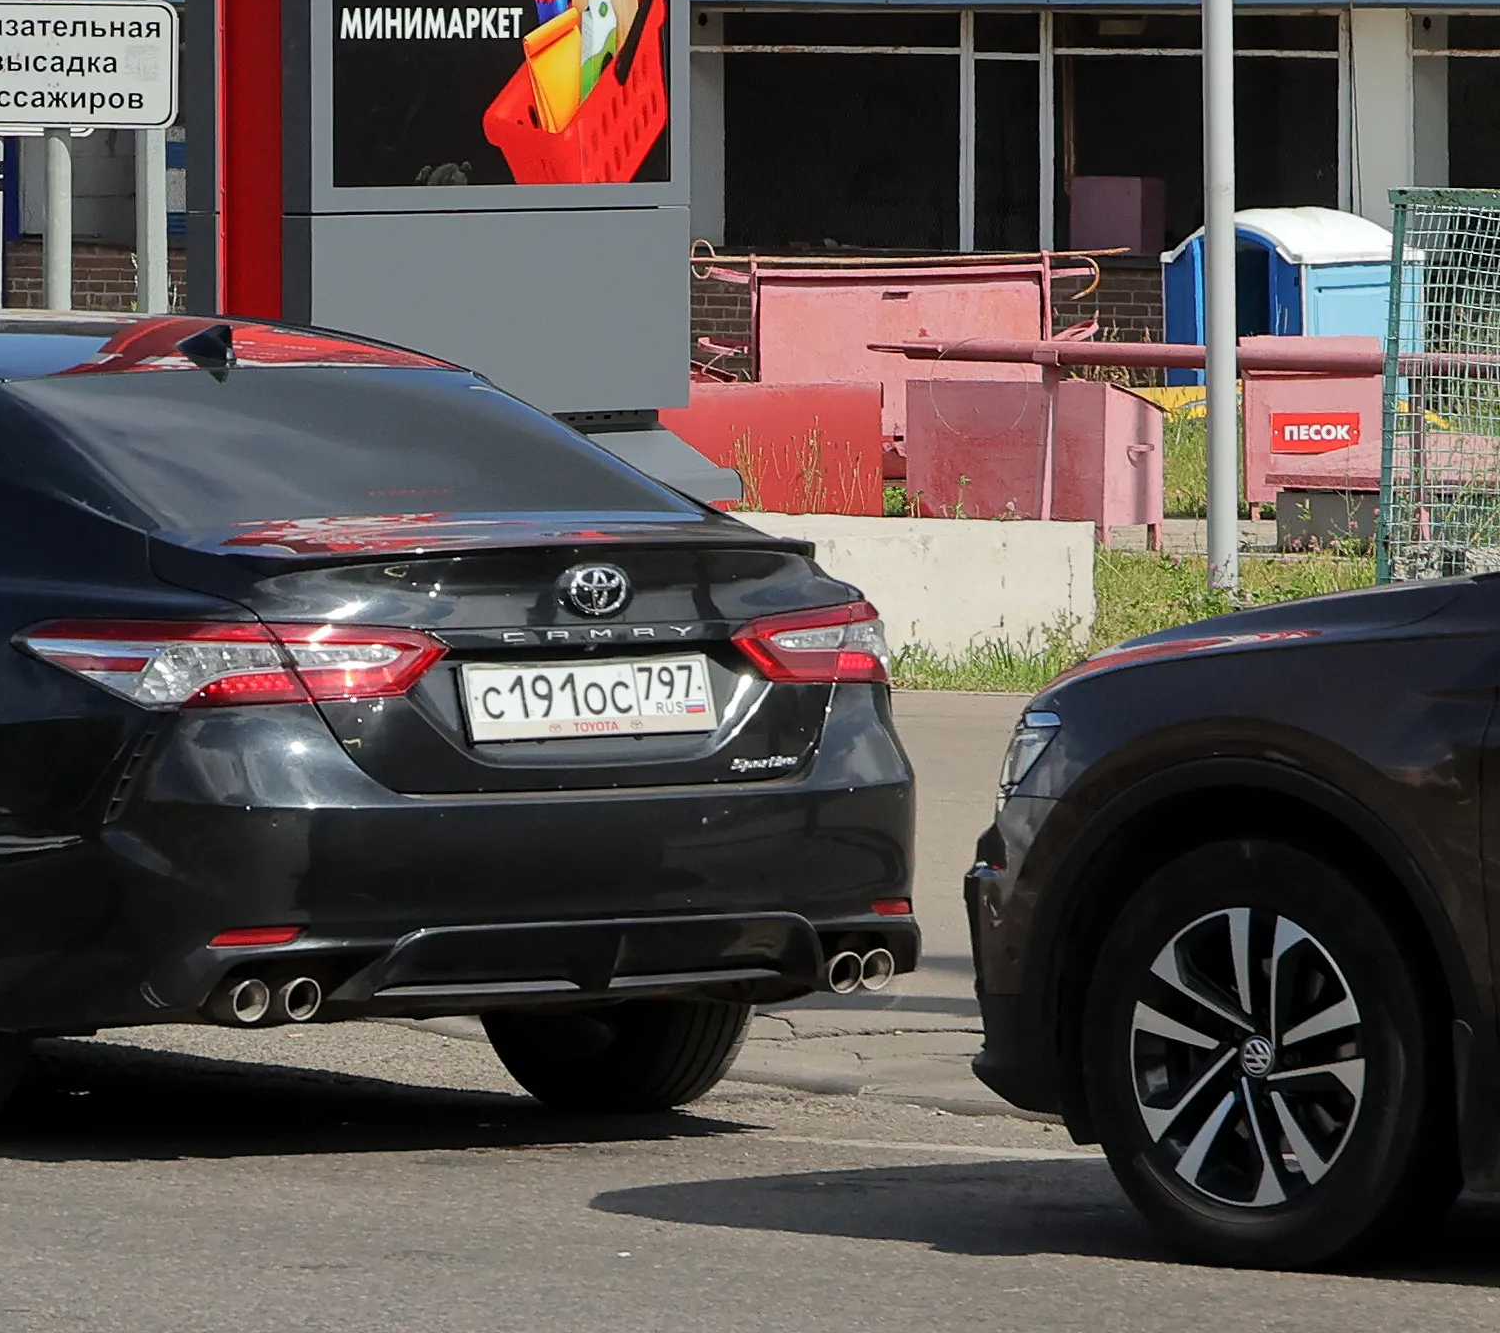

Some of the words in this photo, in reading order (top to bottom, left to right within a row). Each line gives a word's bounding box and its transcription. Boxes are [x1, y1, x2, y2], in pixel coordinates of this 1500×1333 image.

[340, 6, 524, 40] МИНИМАРКЕТ
[1283, 424, 1351, 441] ПЕСОК
[502, 624, 694, 643] CAMRY
[482, 671, 633, 720] С191ОС
[636, 664, 694, 701] 797
[655, 700, 684, 715] RUS
[572, 720, 620, 732] TOYOTA
